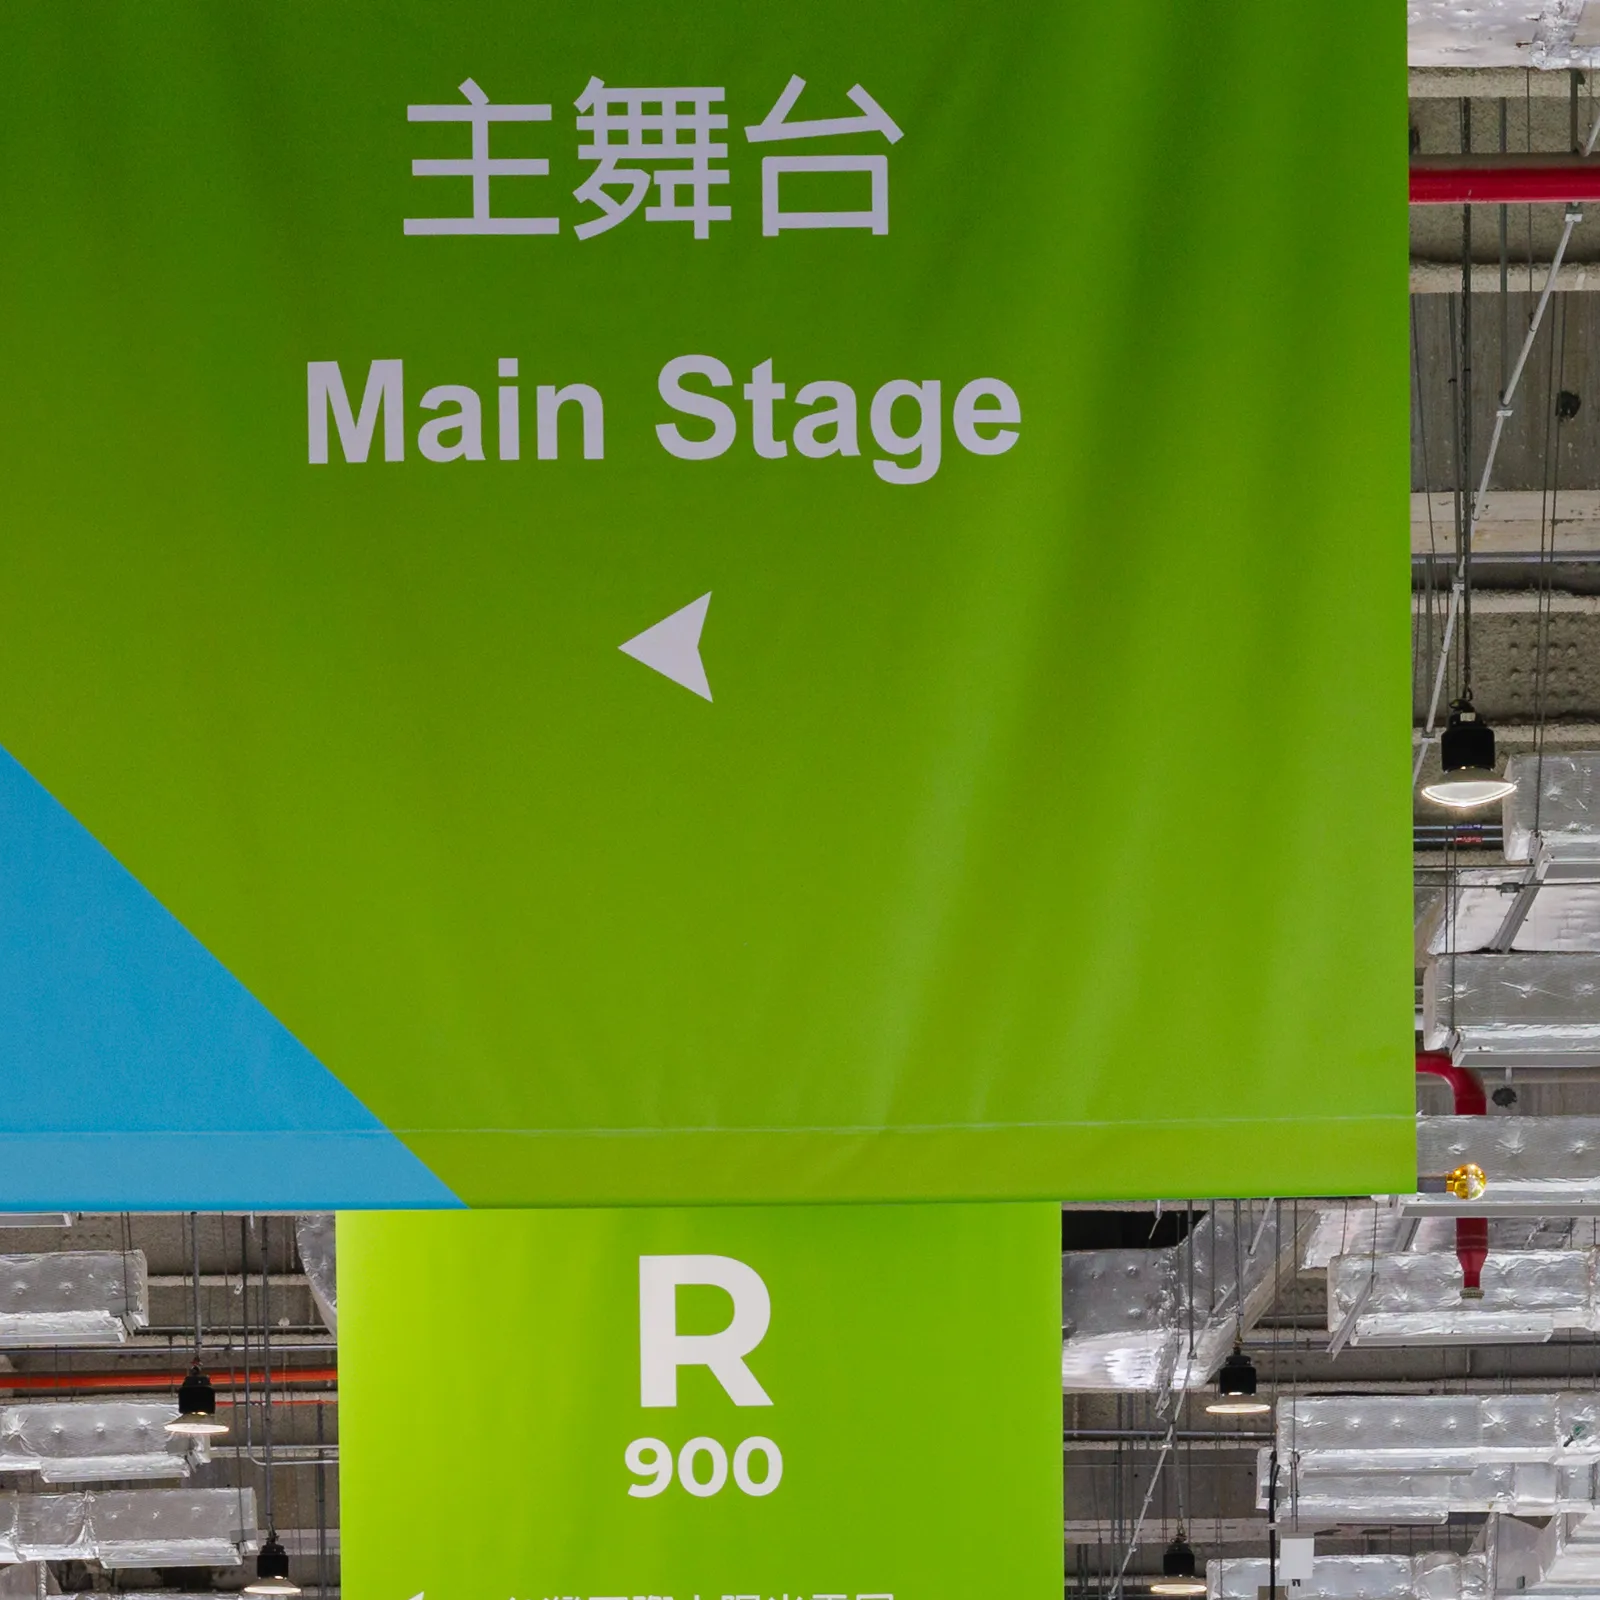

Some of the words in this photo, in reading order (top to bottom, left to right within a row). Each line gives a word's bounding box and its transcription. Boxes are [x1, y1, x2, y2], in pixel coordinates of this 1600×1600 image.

[403, 73, 905, 241] 主舞台
[306, 357, 605, 465] Main
[654, 354, 1022, 485] Stage
[638, 1254, 775, 1408] R
[624, 1436, 784, 1499] 900
